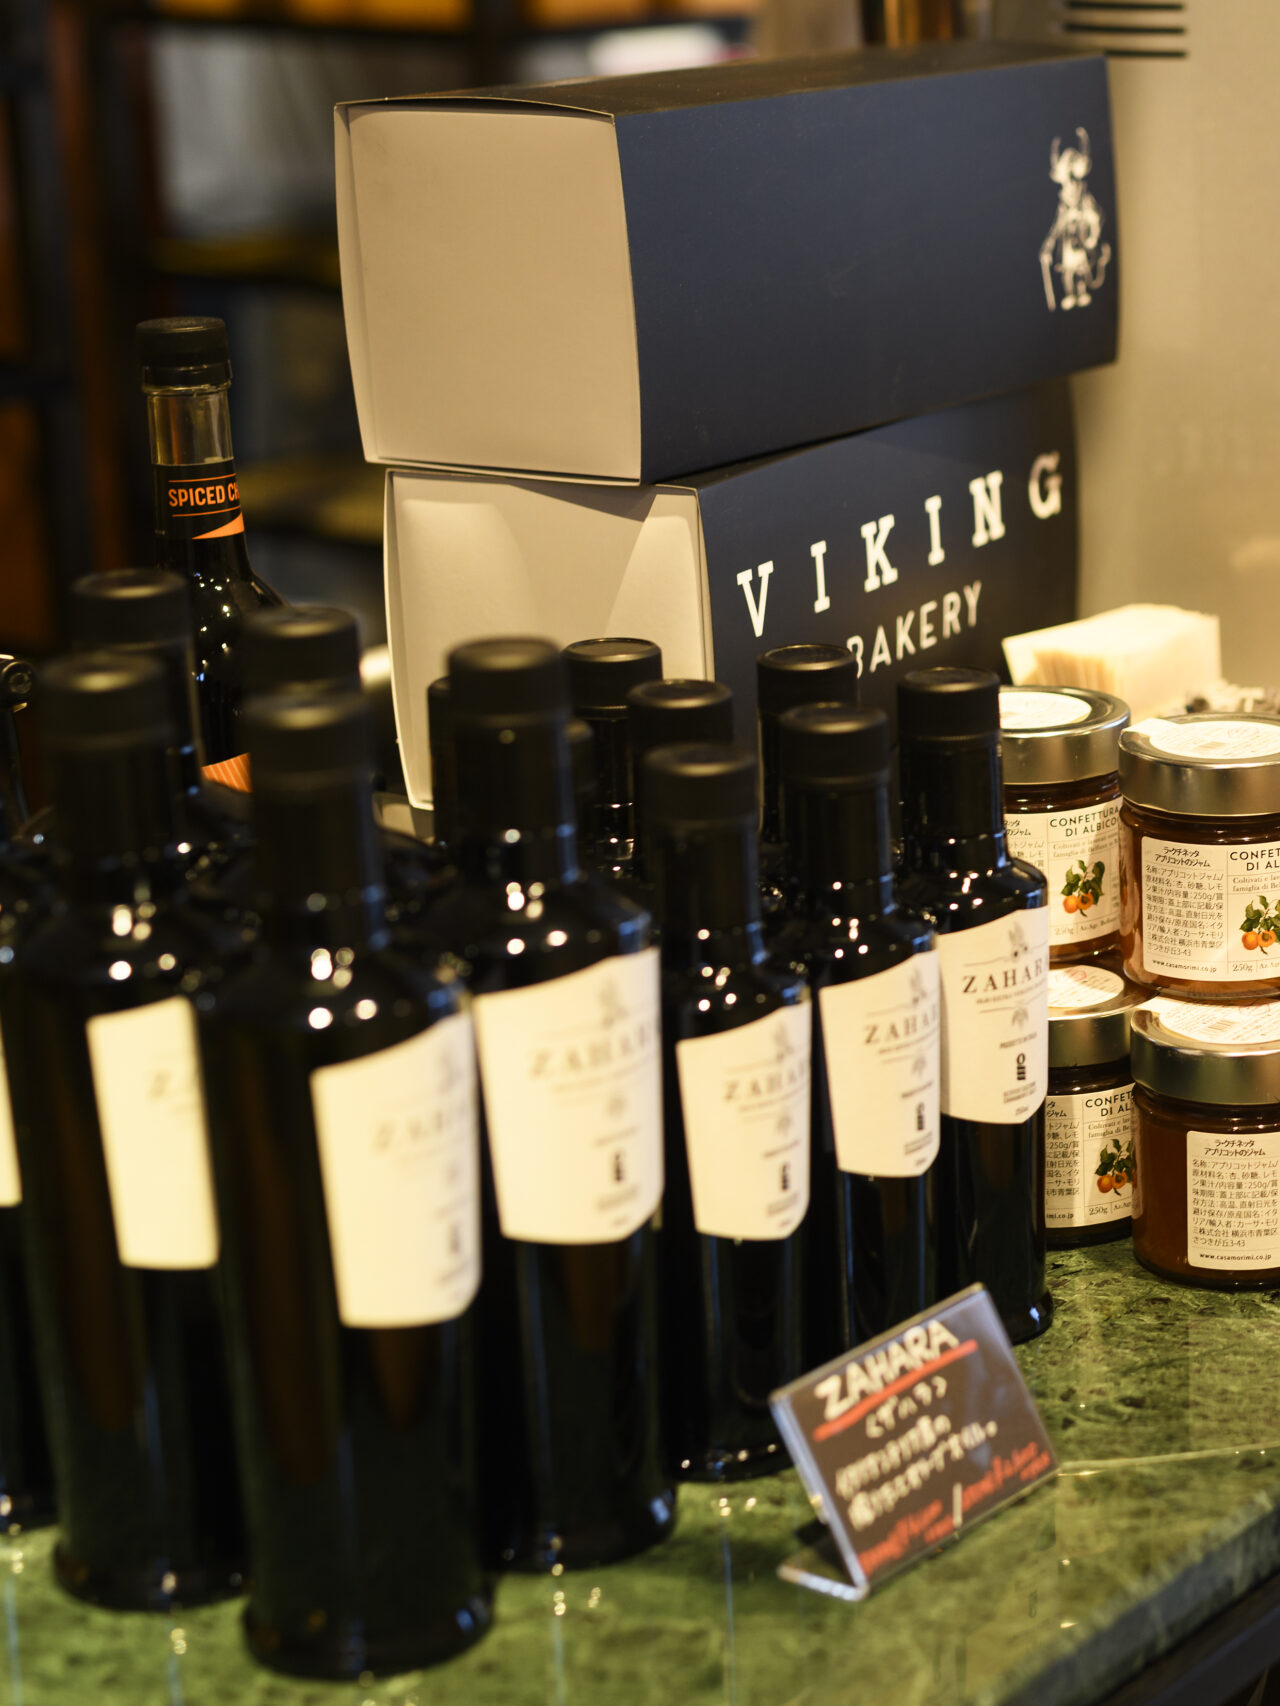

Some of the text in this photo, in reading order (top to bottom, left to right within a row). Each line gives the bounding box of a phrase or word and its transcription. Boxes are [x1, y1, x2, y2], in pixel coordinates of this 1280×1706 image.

[168, 485, 226, 507] SPICED
[736, 451, 1063, 638] VIKING
[846, 581, 983, 679] BAKERY
[1050, 806, 1119, 828] CONFETTURA
[1065, 817, 1117, 837] DI ALBICO
[1246, 862, 1259, 871] DI
[962, 954, 1047, 993] ZAHAR
[1101, 1107, 1113, 1116] DI
[1204, 1148, 1266, 1156] アプリコットのジャム
[814, 1319, 960, 1421] ZAHARA
